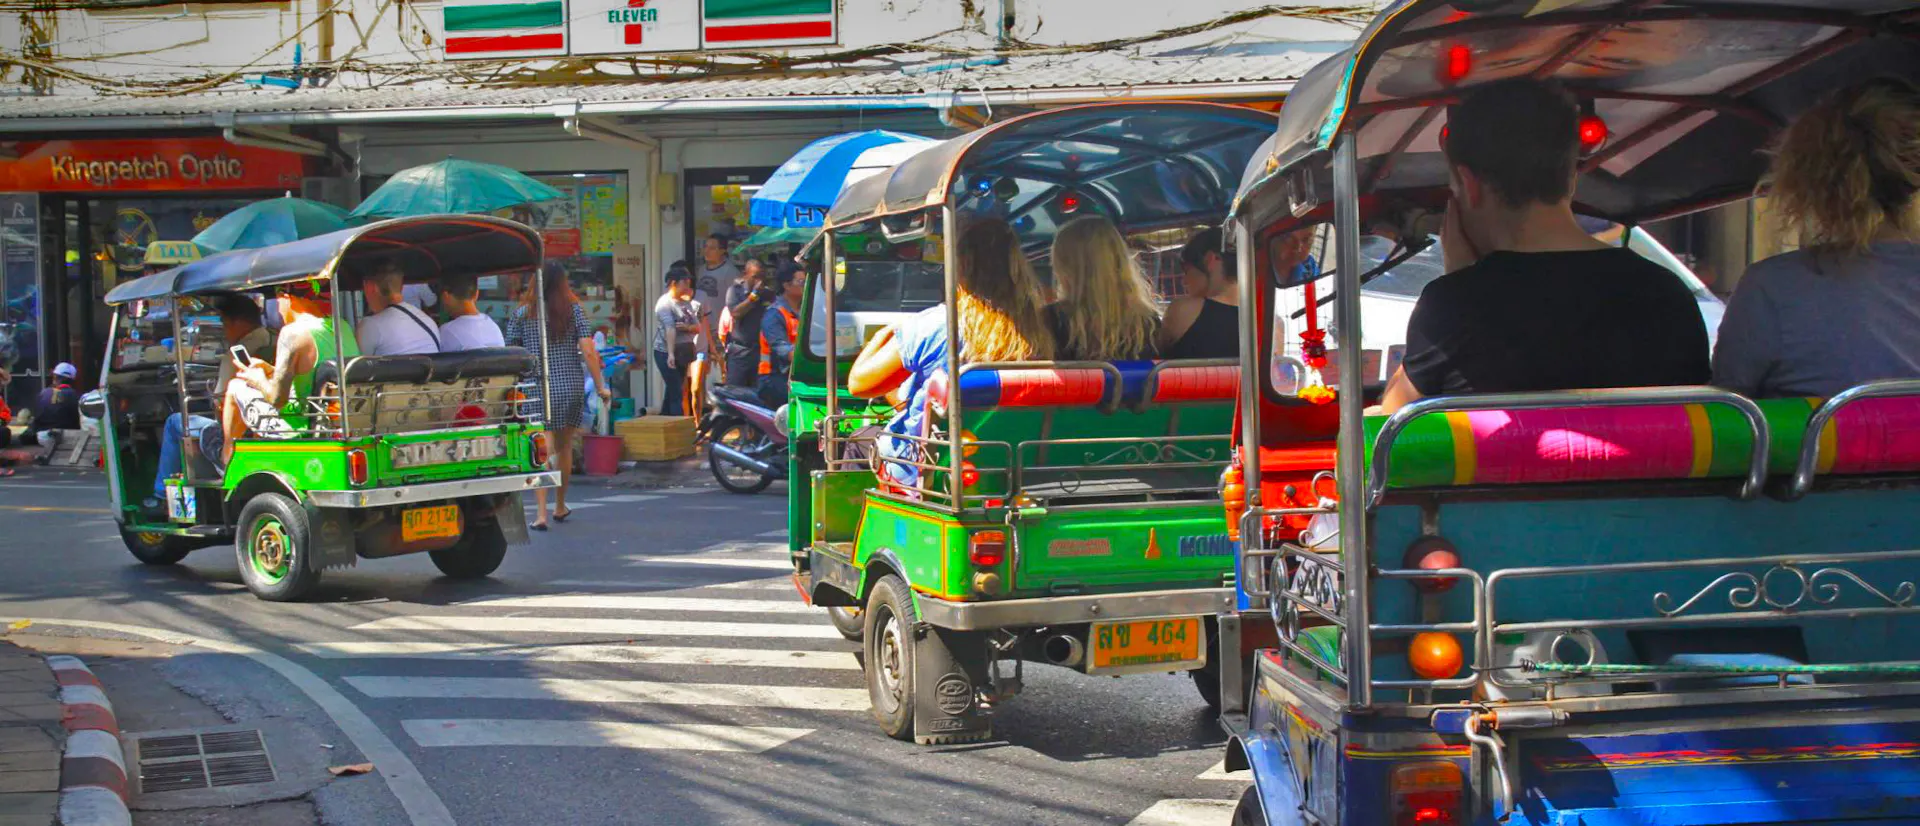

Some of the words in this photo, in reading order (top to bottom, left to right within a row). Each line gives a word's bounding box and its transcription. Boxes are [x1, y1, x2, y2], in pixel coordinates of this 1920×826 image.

[51, 154, 170, 186] Kingpetch
[178, 153, 243, 184] Optic
[158, 244, 192, 258] TAXI
[1147, 619, 1186, 646] 464
